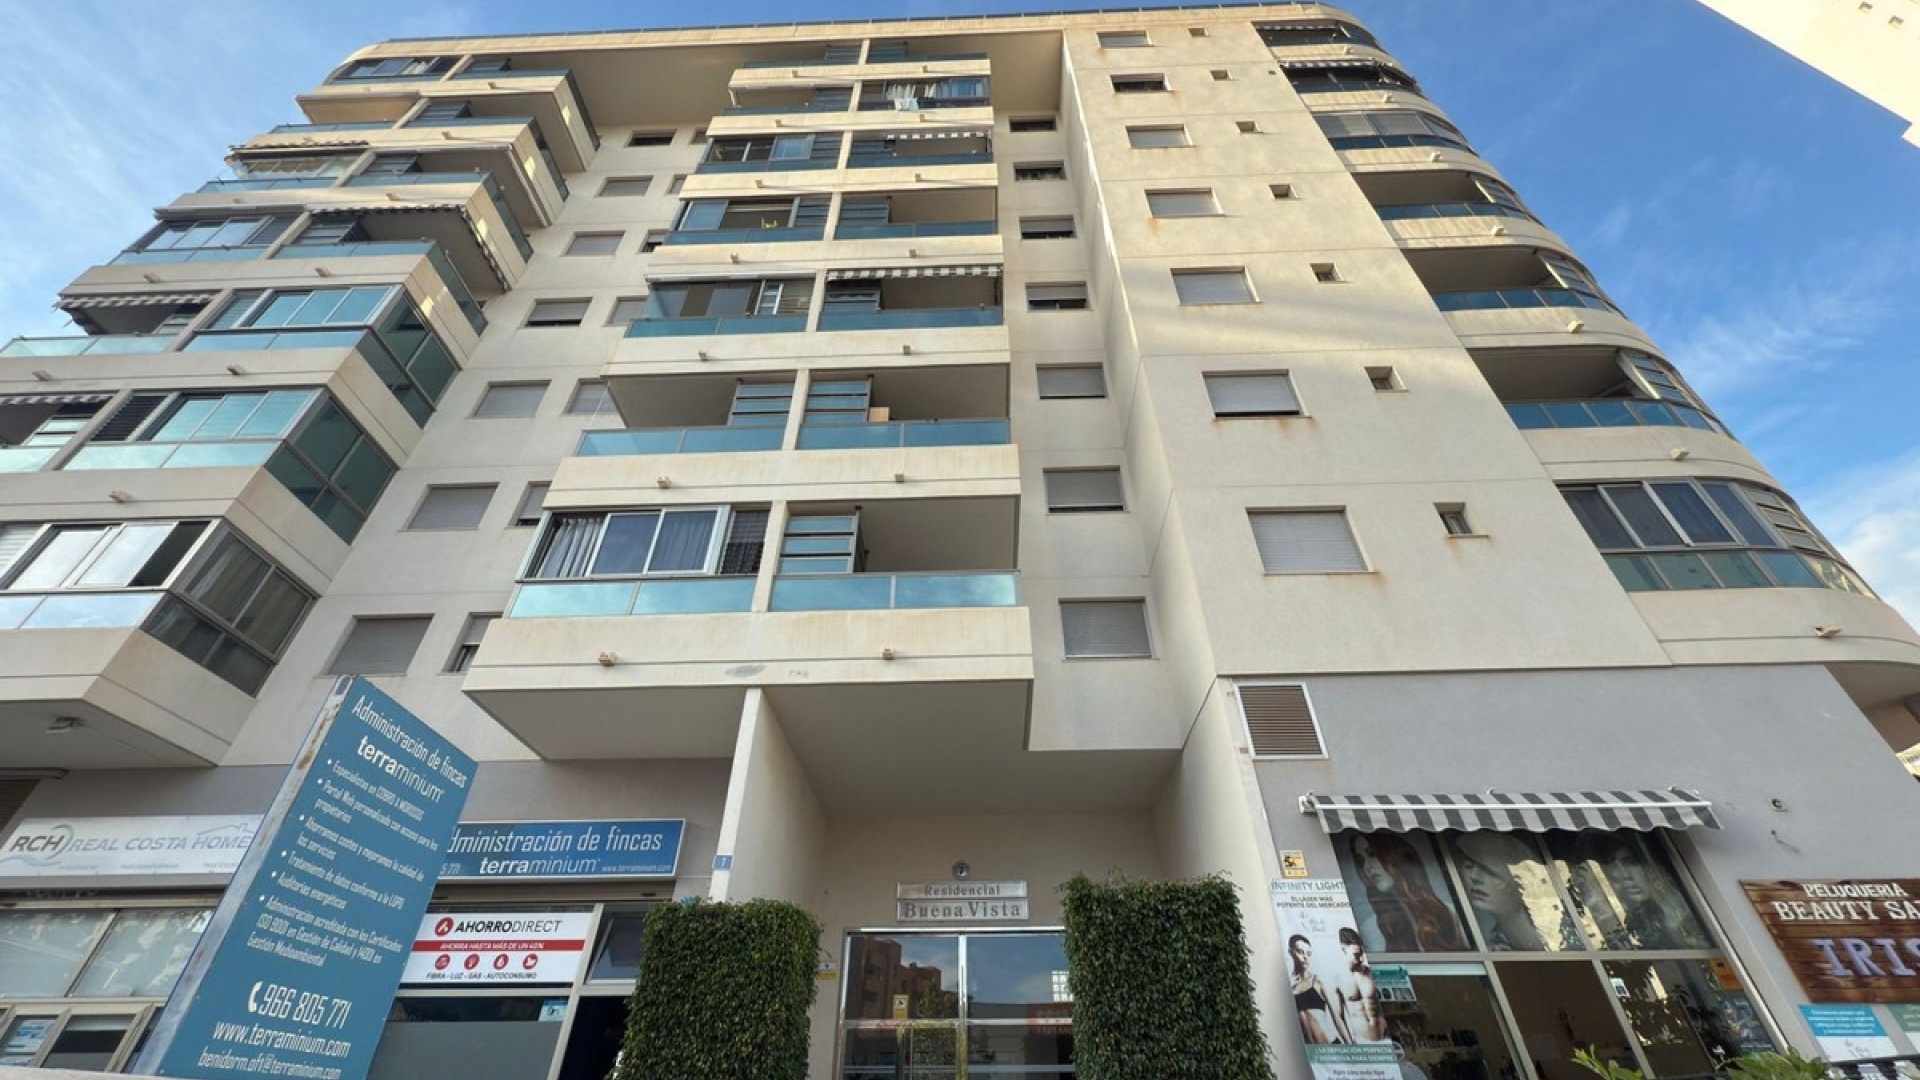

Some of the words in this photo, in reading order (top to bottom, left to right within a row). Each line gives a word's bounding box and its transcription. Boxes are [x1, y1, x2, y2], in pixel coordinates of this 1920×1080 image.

[352, 694, 428, 762] Administración
[427, 748, 441, 770] de
[440, 756, 468, 788] fincas
[357, 735, 443, 803] terraminium
[10, 835, 64, 852] RCH
[71, 838, 120, 851] REAL
[124, 836, 187, 850] COSTA
[447, 827, 572, 853] dministración
[577, 827, 600, 851] de
[605, 826, 664, 851] fincas
[480, 856, 598, 874] terraminium
[924, 884, 1000, 896] Residencial
[1315, 882, 1345, 890] LIGHT
[904, 902, 964, 918] Buena
[968, 901, 1022, 918] Vista
[1772, 901, 1880, 920] BEAUTY
[1883, 901, 1920, 920] SA
[454, 920, 562, 932] AHORRODIRECT
[450, 972, 464, 980] LUZ
[258, 984, 296, 1020] 966
[292, 992, 328, 1026] 805
[325, 998, 352, 1029] 771
[212, 1021, 351, 1059] www.terraminium.com
